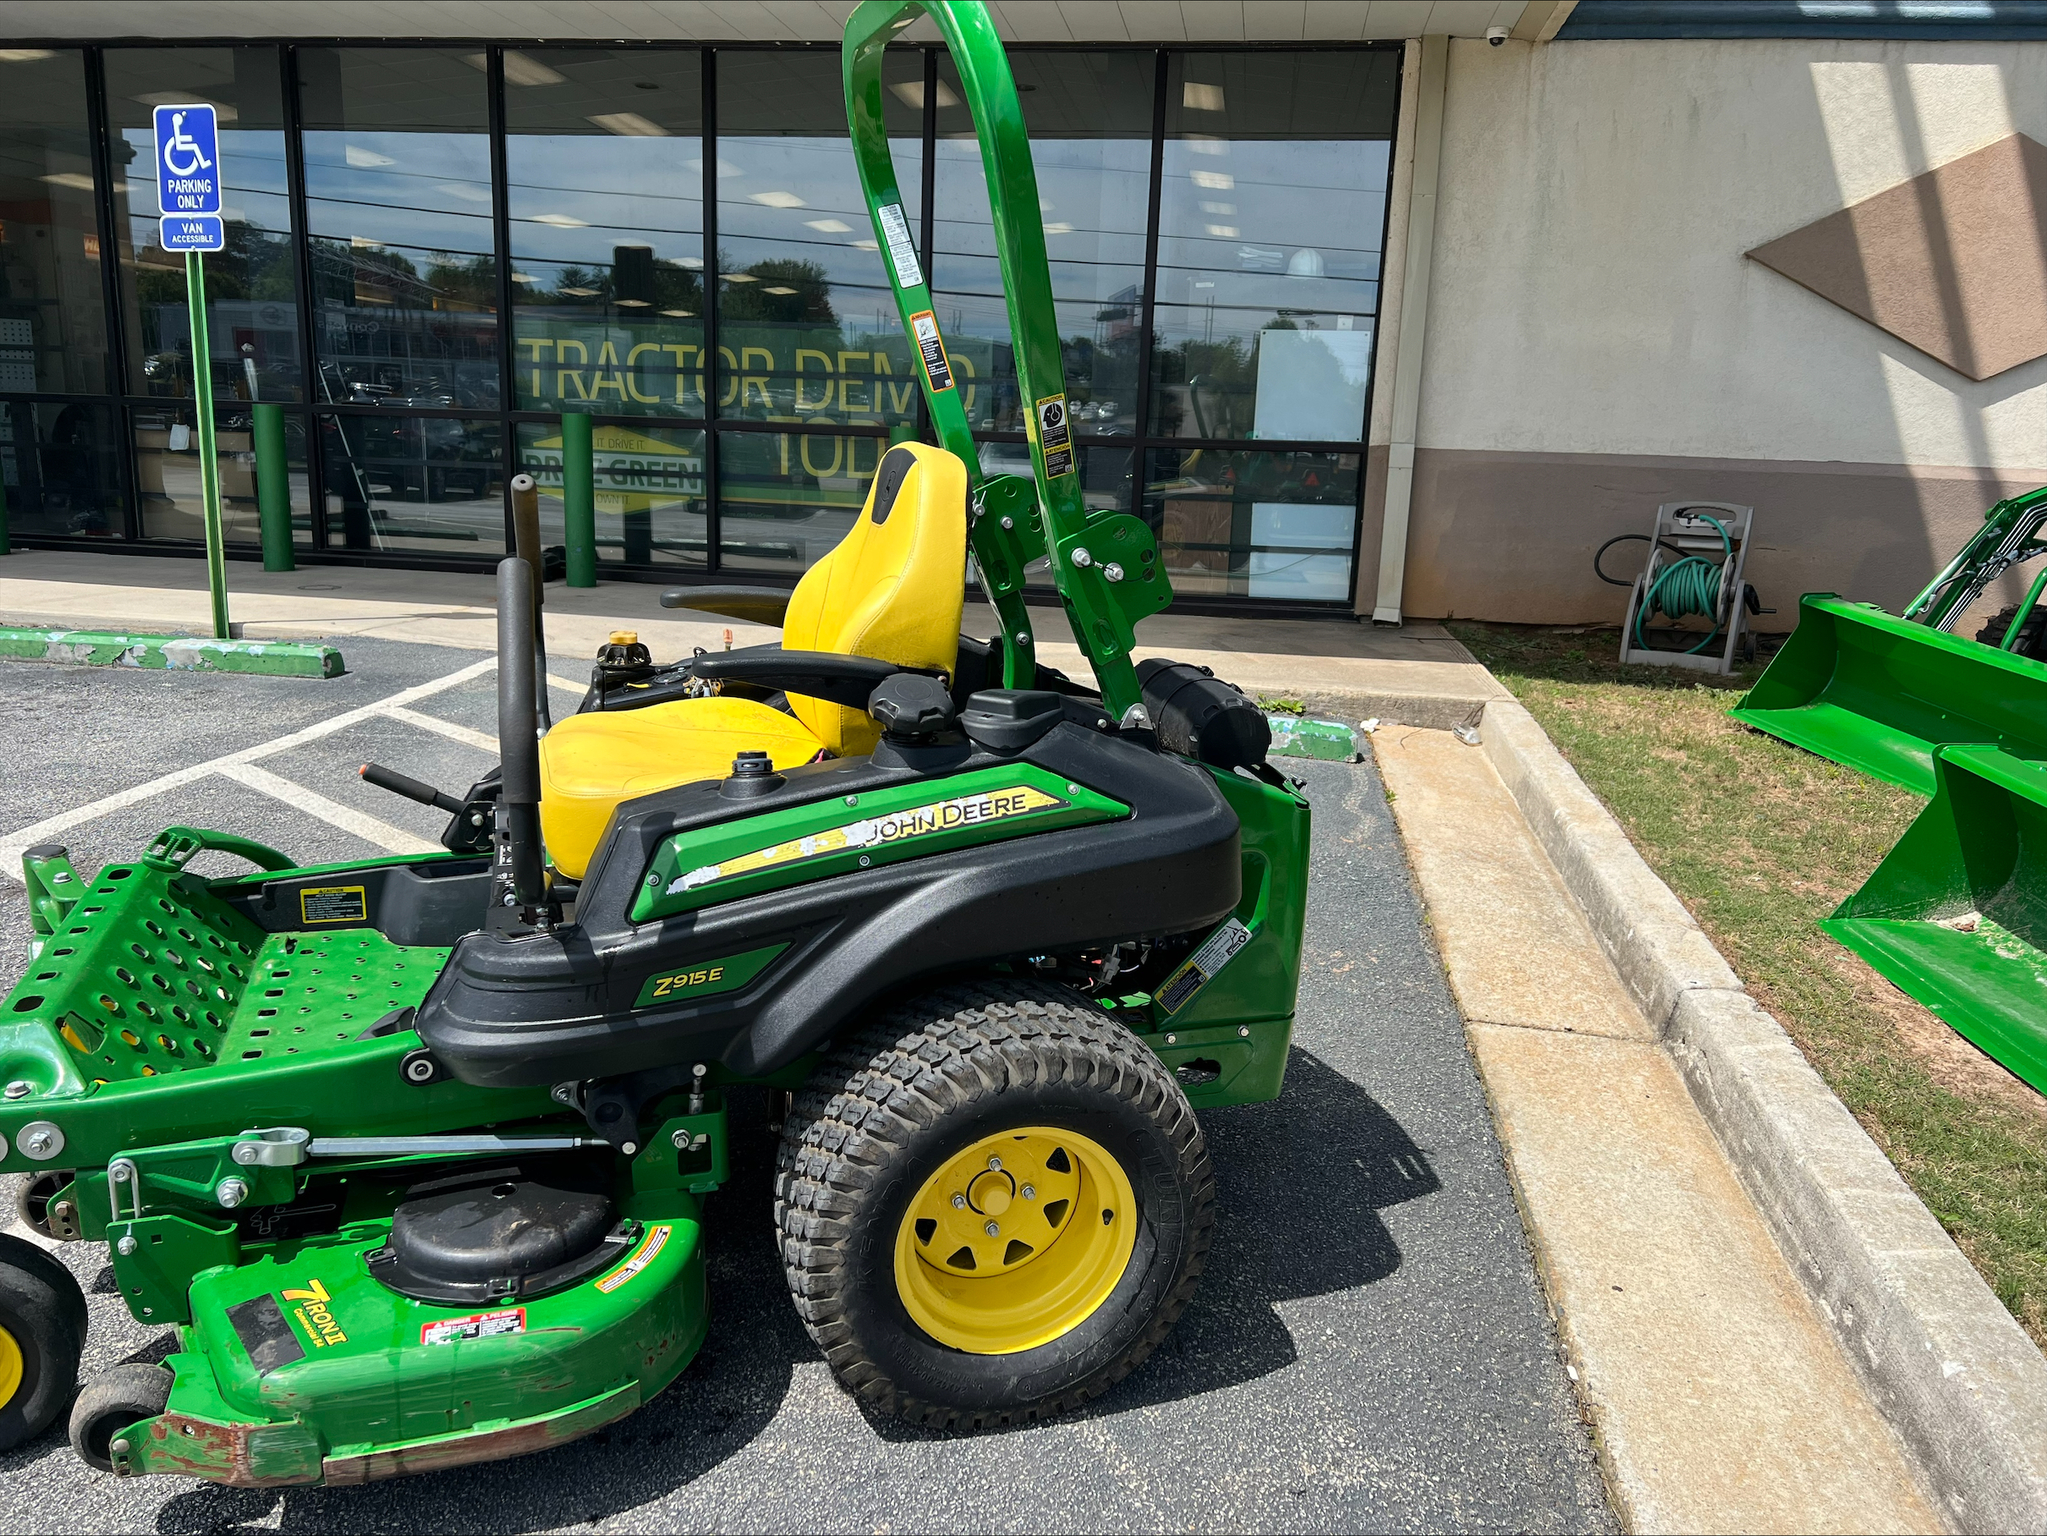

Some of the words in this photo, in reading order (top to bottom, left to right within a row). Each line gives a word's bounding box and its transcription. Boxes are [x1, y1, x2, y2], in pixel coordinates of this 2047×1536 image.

[167, 179, 212, 194] PARKING
[177, 195, 205, 209] ONLY
[181, 223, 203, 234] VAN
[172, 234, 214, 243] ACCESSIBLE
[518, 338, 774, 409] TRACTOR
[1043, 394, 1063, 403] CAUTION
[608, 439, 634, 450] DRIVE
[525, 454, 603, 485] DRE
[609, 459, 698, 490] GREEN
[595, 494, 619, 504] OWN
[866, 811, 936, 842] JOHN
[942, 794, 1027, 826] DEERE
[294, 1308, 320, 1341] Commercial
[443, 1318, 471, 1326] DANGER
[490, 1309, 518, 1319] PELIGRO
